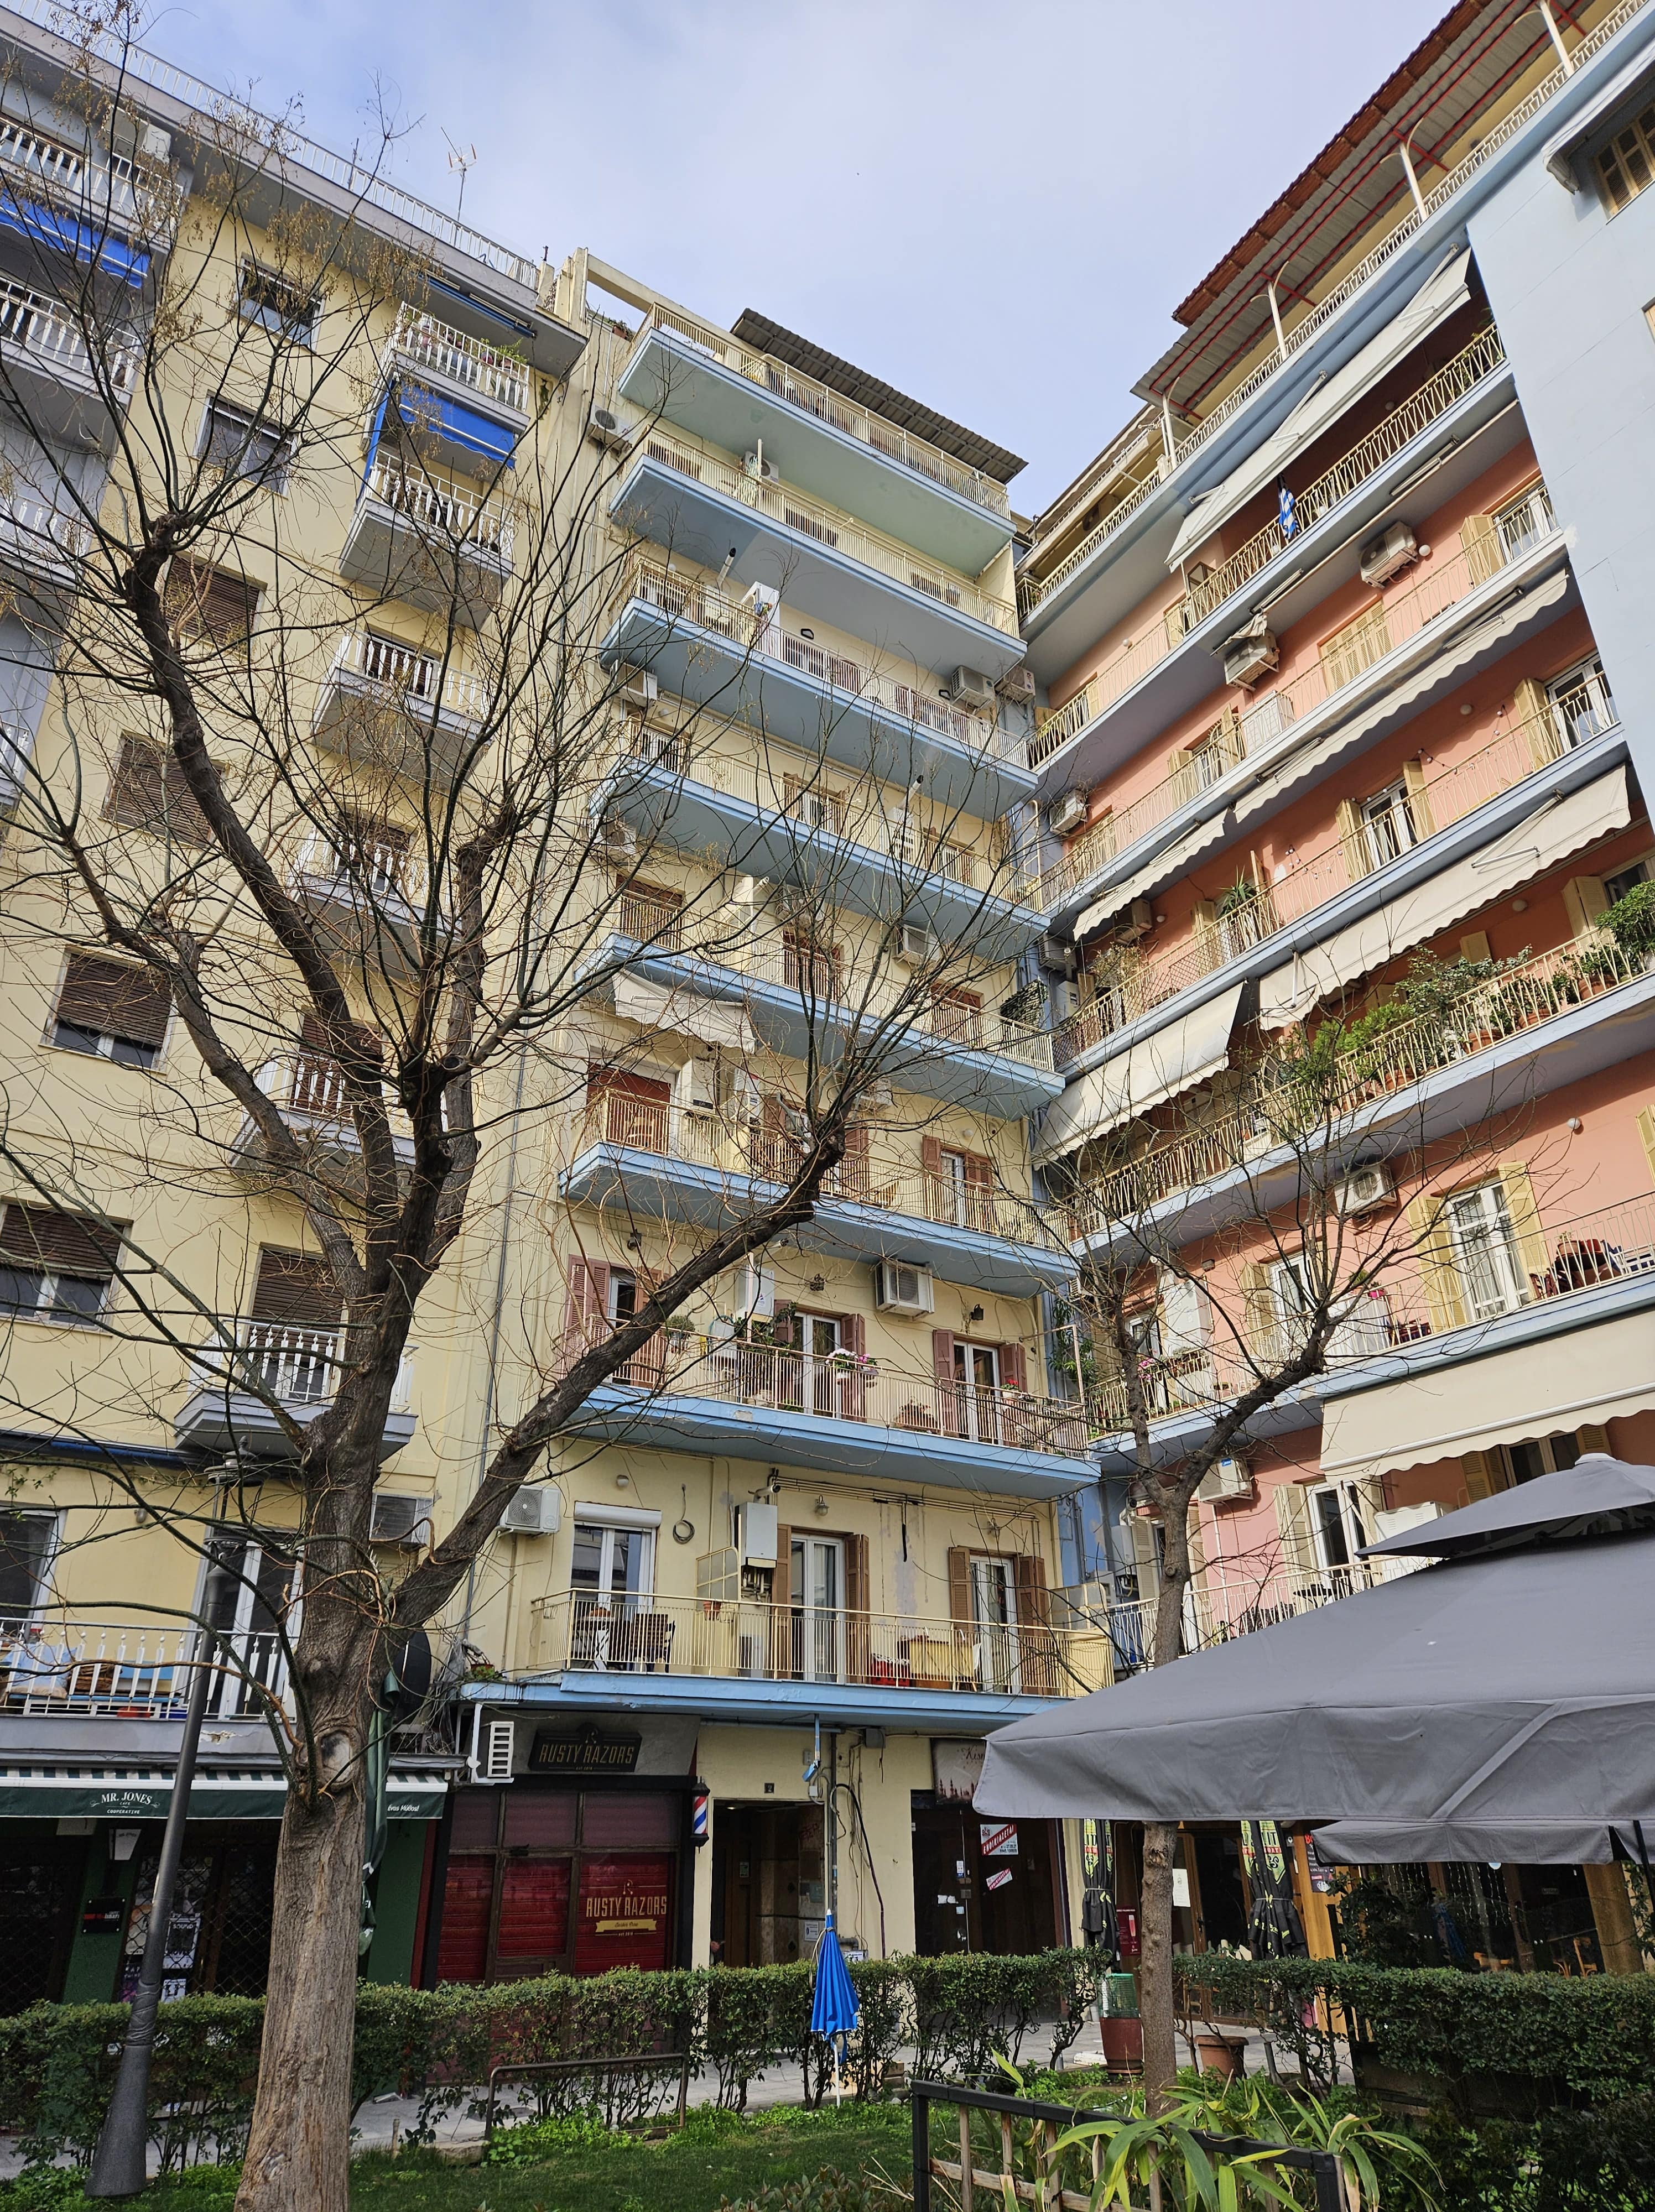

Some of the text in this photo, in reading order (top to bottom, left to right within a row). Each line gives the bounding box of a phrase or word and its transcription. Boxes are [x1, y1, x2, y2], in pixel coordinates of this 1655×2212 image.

[539, 1744, 634, 1764] RUSTY RAZORS
[101, 1791, 153, 1805] MR. JONES
[983, 1824, 1014, 1855] ΕΝΟΙΚΙΑΖΕΤΑΙ
[586, 1896, 667, 1917] RUSTY RAZORS
